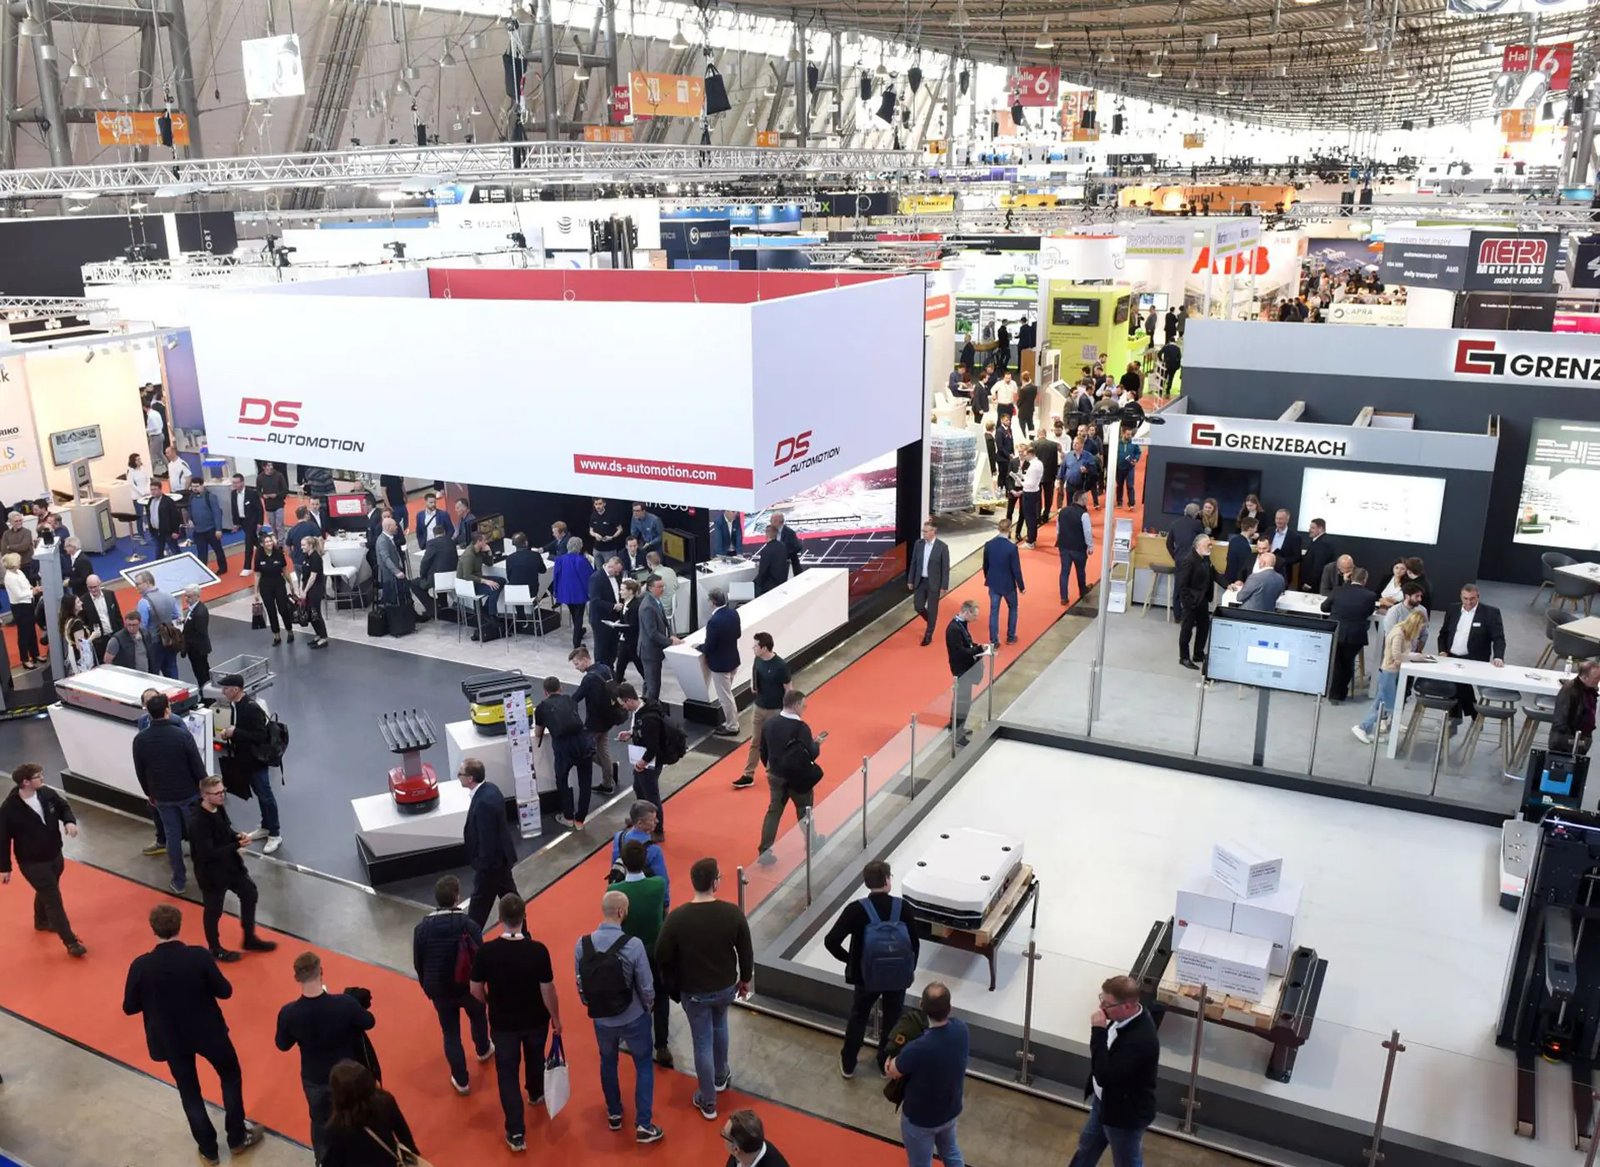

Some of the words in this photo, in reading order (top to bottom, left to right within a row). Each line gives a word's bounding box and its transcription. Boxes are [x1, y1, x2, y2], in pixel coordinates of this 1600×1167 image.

[1540, 47, 1559, 76] 6
[1034, 71, 1050, 95] 6
[1191, 246, 1270, 275] ABB
[1519, 276, 1543, 285] robots
[239, 397, 302, 429] DS
[267, 432, 365, 453] AUTOMOTION
[774, 430, 812, 467] DS
[1225, 433, 1347, 457] GRENZEBACH
[580, 459, 717, 481] www.ds-automotion.com
[790, 446, 840, 474] AUTOMOTION
